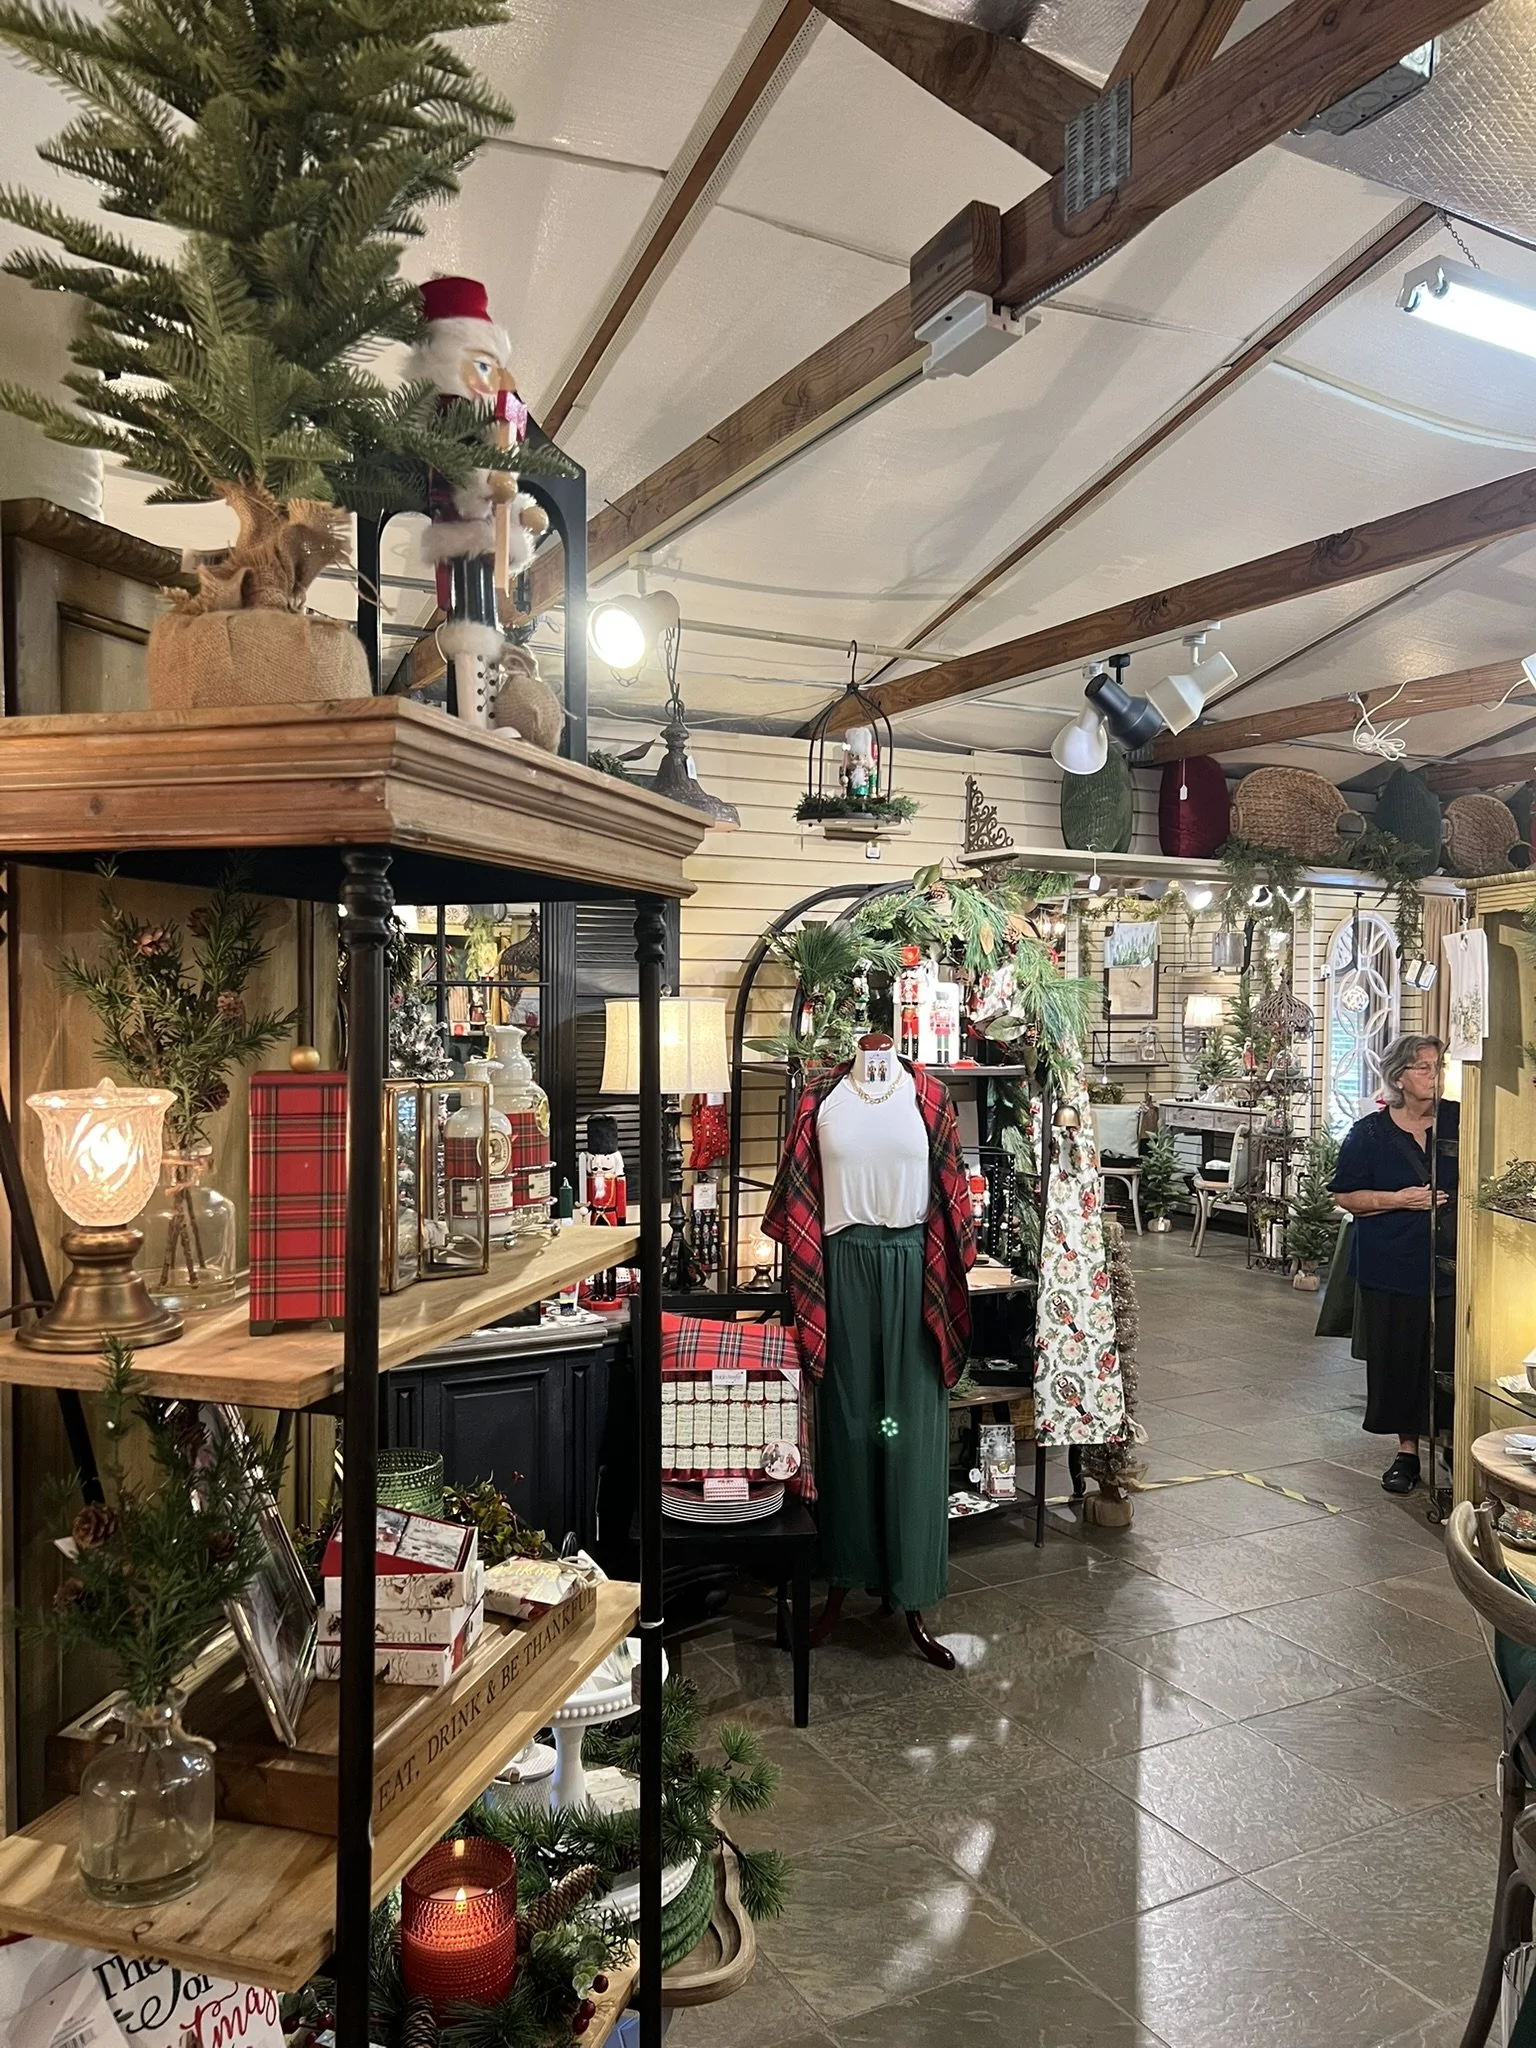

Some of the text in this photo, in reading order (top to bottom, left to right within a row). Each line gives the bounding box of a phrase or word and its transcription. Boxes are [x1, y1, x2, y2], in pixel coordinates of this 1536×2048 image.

[378, 1586, 595, 1812] EAT, DRINK & BE THANKFUL
